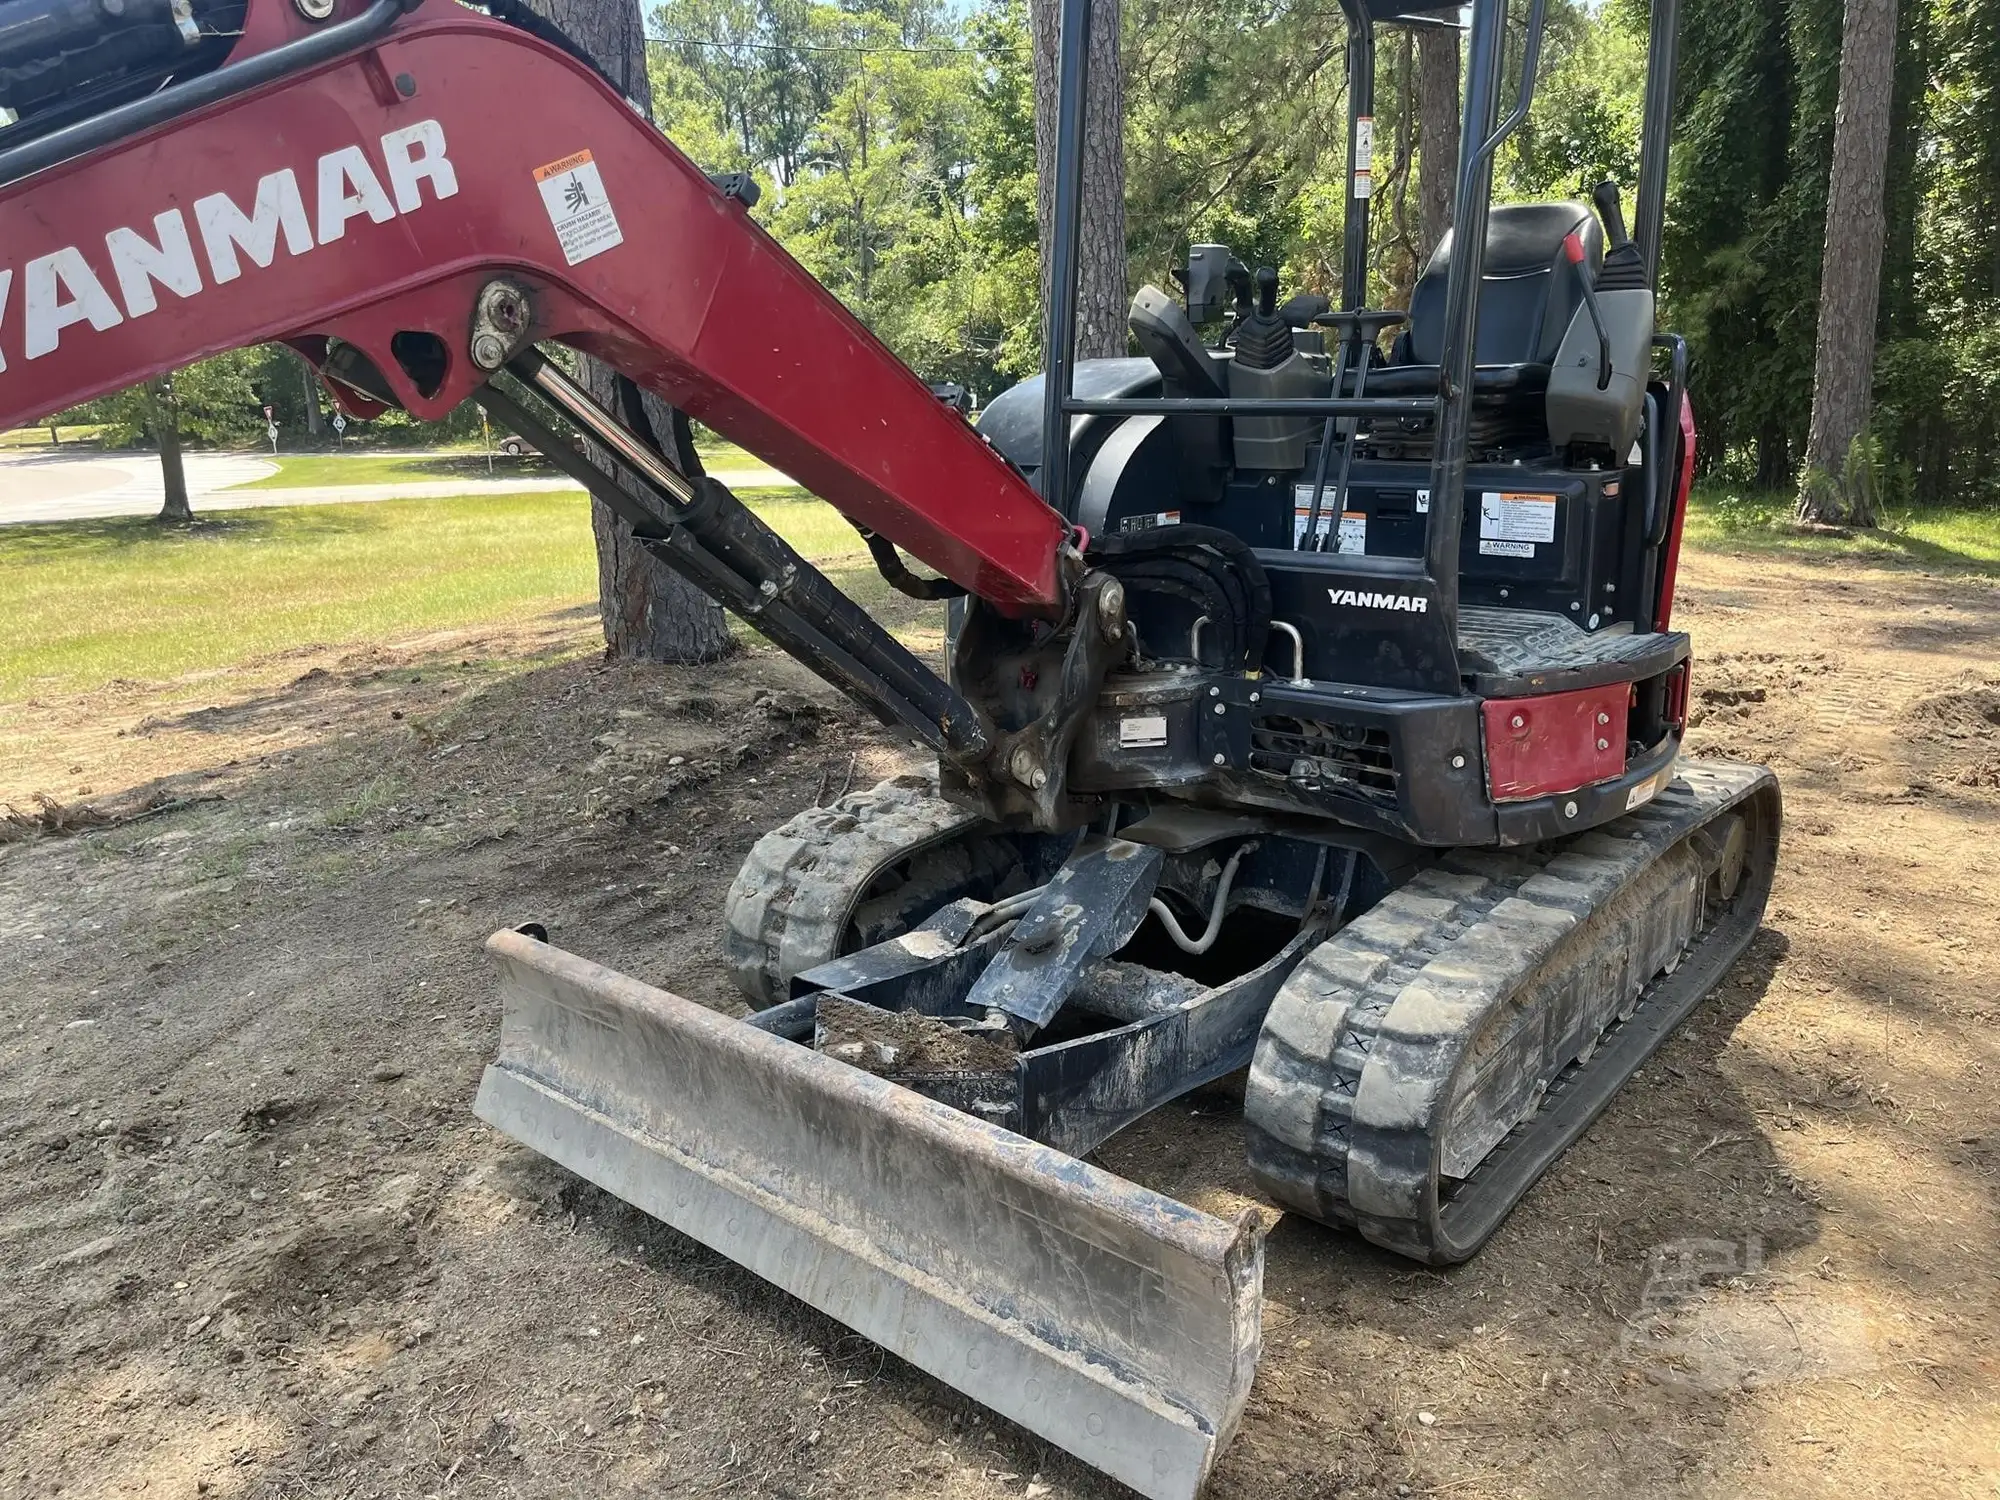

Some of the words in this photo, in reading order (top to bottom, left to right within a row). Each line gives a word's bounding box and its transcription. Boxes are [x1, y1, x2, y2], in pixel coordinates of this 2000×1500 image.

[548, 154, 585, 174] WARNING
[557, 220, 577, 232] CRUSH
[0, 119, 459, 374] ANMAR
[1492, 542, 1530, 550] WARNING
[1327, 589, 1428, 612] YANMAR
